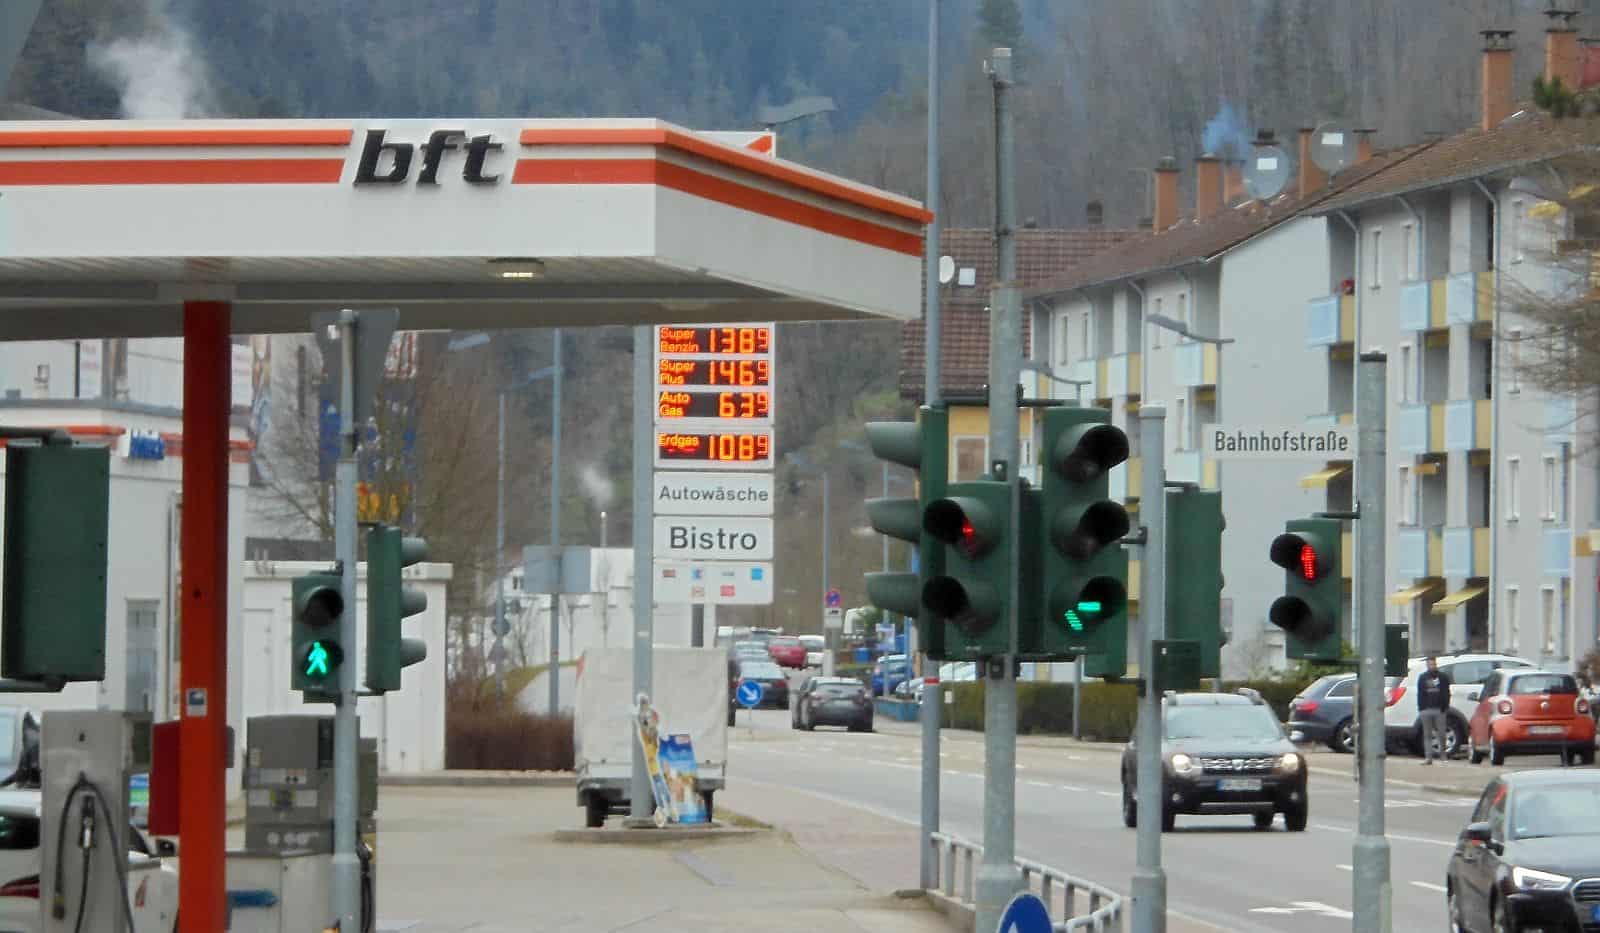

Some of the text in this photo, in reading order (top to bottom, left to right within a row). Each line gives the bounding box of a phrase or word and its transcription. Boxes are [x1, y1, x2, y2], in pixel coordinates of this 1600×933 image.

[353, 128, 505, 186] bft
[660, 327, 695, 340] Super
[660, 342, 699, 353] Benzin
[660, 360, 696, 372] Super
[660, 374, 685, 385] Plus
[660, 391, 690, 404] Auto
[660, 405, 683, 417] Gas
[659, 433, 700, 448] Erdgas
[1214, 430, 1349, 452] Bahnhofstraße
[659, 485, 769, 502] Autowäsche
[669, 526, 758, 551] Bistro
